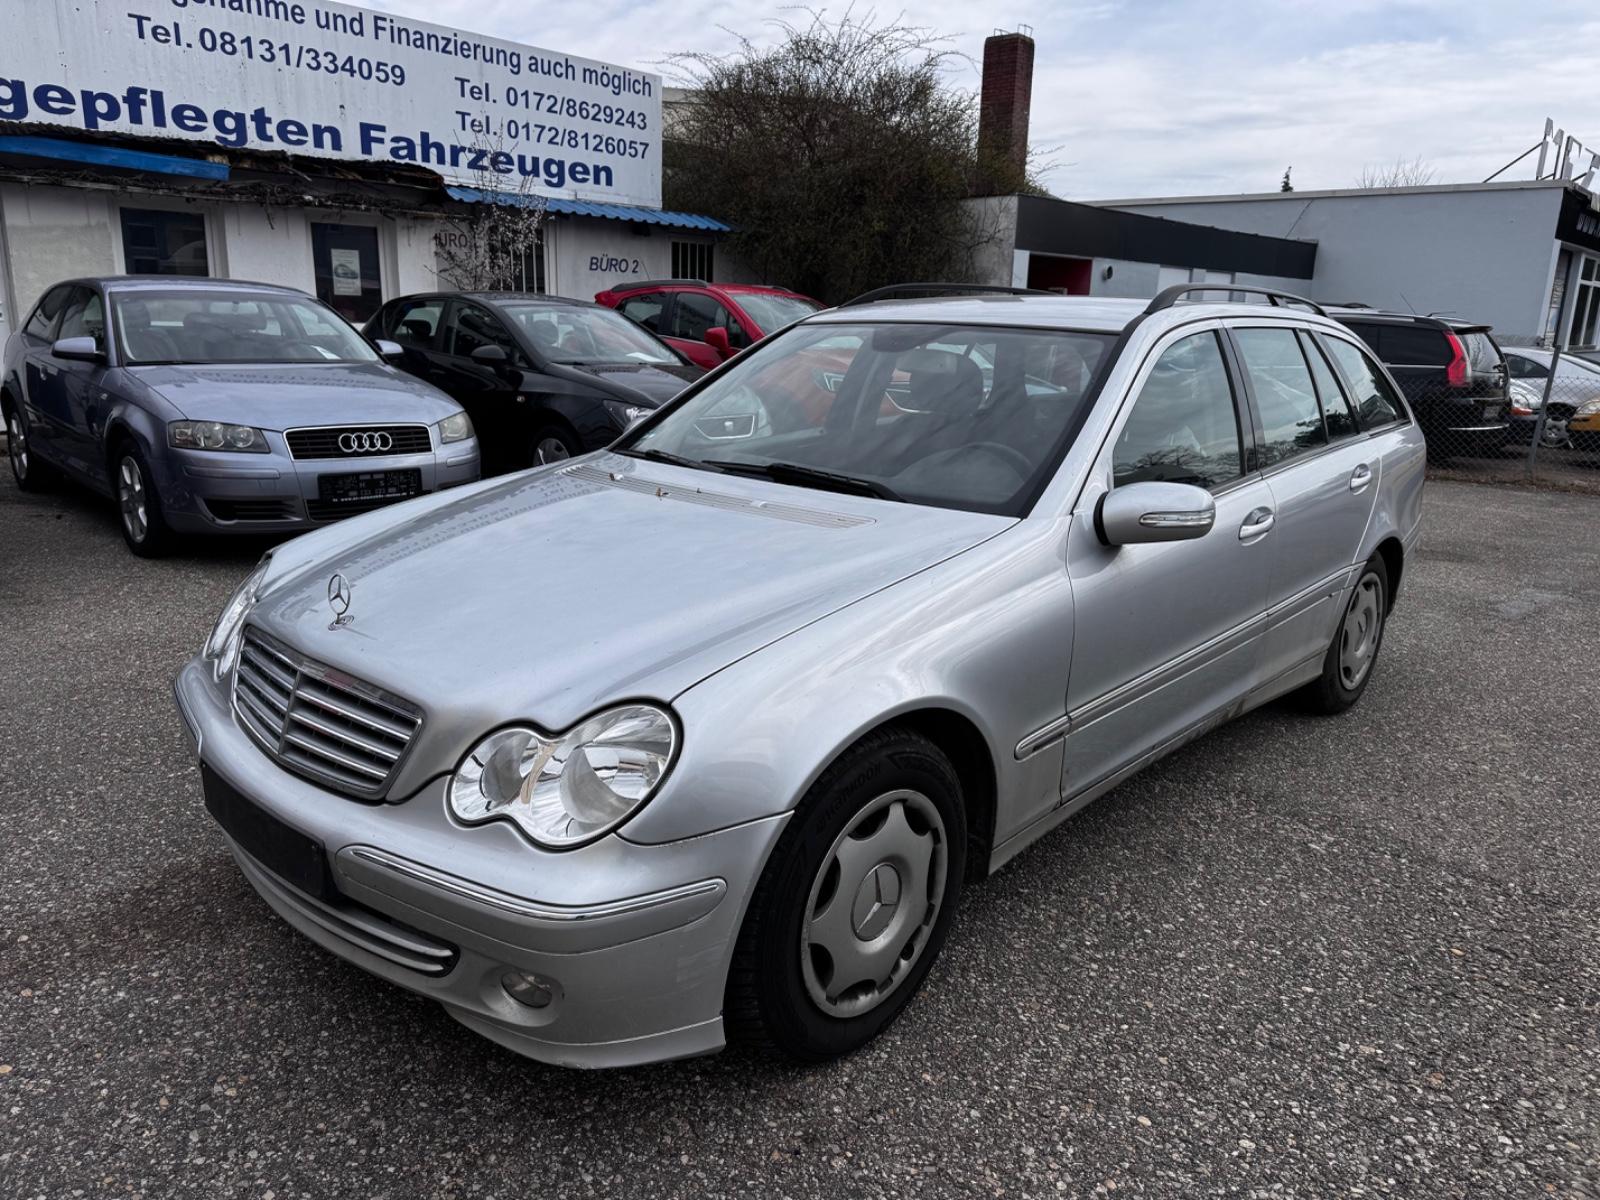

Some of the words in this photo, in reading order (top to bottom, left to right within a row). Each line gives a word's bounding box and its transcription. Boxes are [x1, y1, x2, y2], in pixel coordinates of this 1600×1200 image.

[171, 0, 305, 24] ahme
[315, 8, 364, 37] und
[373, 15, 521, 75] Finanzierung
[527, 53, 576, 81] auch
[582, 66, 652, 97] möglich
[454, 76, 497, 104] Tel.
[505, 86, 647, 131] 0172/8629243
[0, 76, 343, 151] gepflegten
[359, 121, 614, 188] Fahrzeugen
[455, 110, 498, 136] Tel.
[507, 119, 650, 160] 0172/8126057
[589, 253, 629, 273] BÜRO
[631, 259, 640, 274] 2
